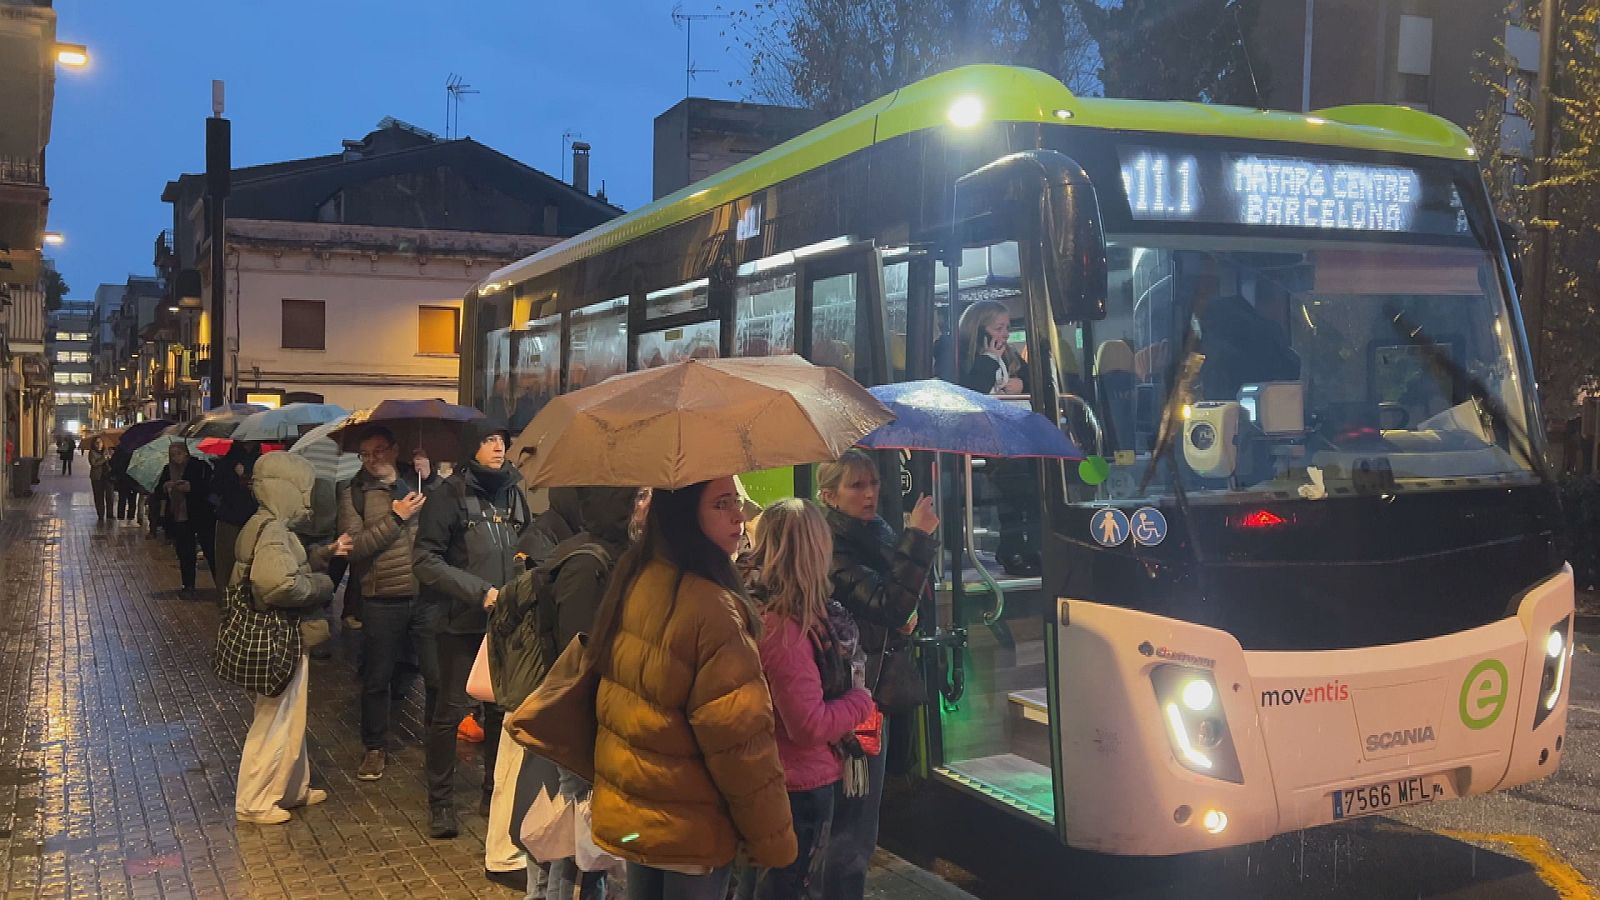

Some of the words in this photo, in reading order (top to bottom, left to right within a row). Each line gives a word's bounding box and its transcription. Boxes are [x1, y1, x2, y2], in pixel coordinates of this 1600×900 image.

[1121, 158, 1192, 213] 11.1
[1333, 170, 1411, 203] CENTRE
[1246, 194, 1401, 231] BARCELONA
[1261, 680, 1349, 707] moventis
[1366, 726, 1435, 752] SCANIA
[1345, 784, 1391, 814] 7566
[1398, 778, 1430, 804] MFL
